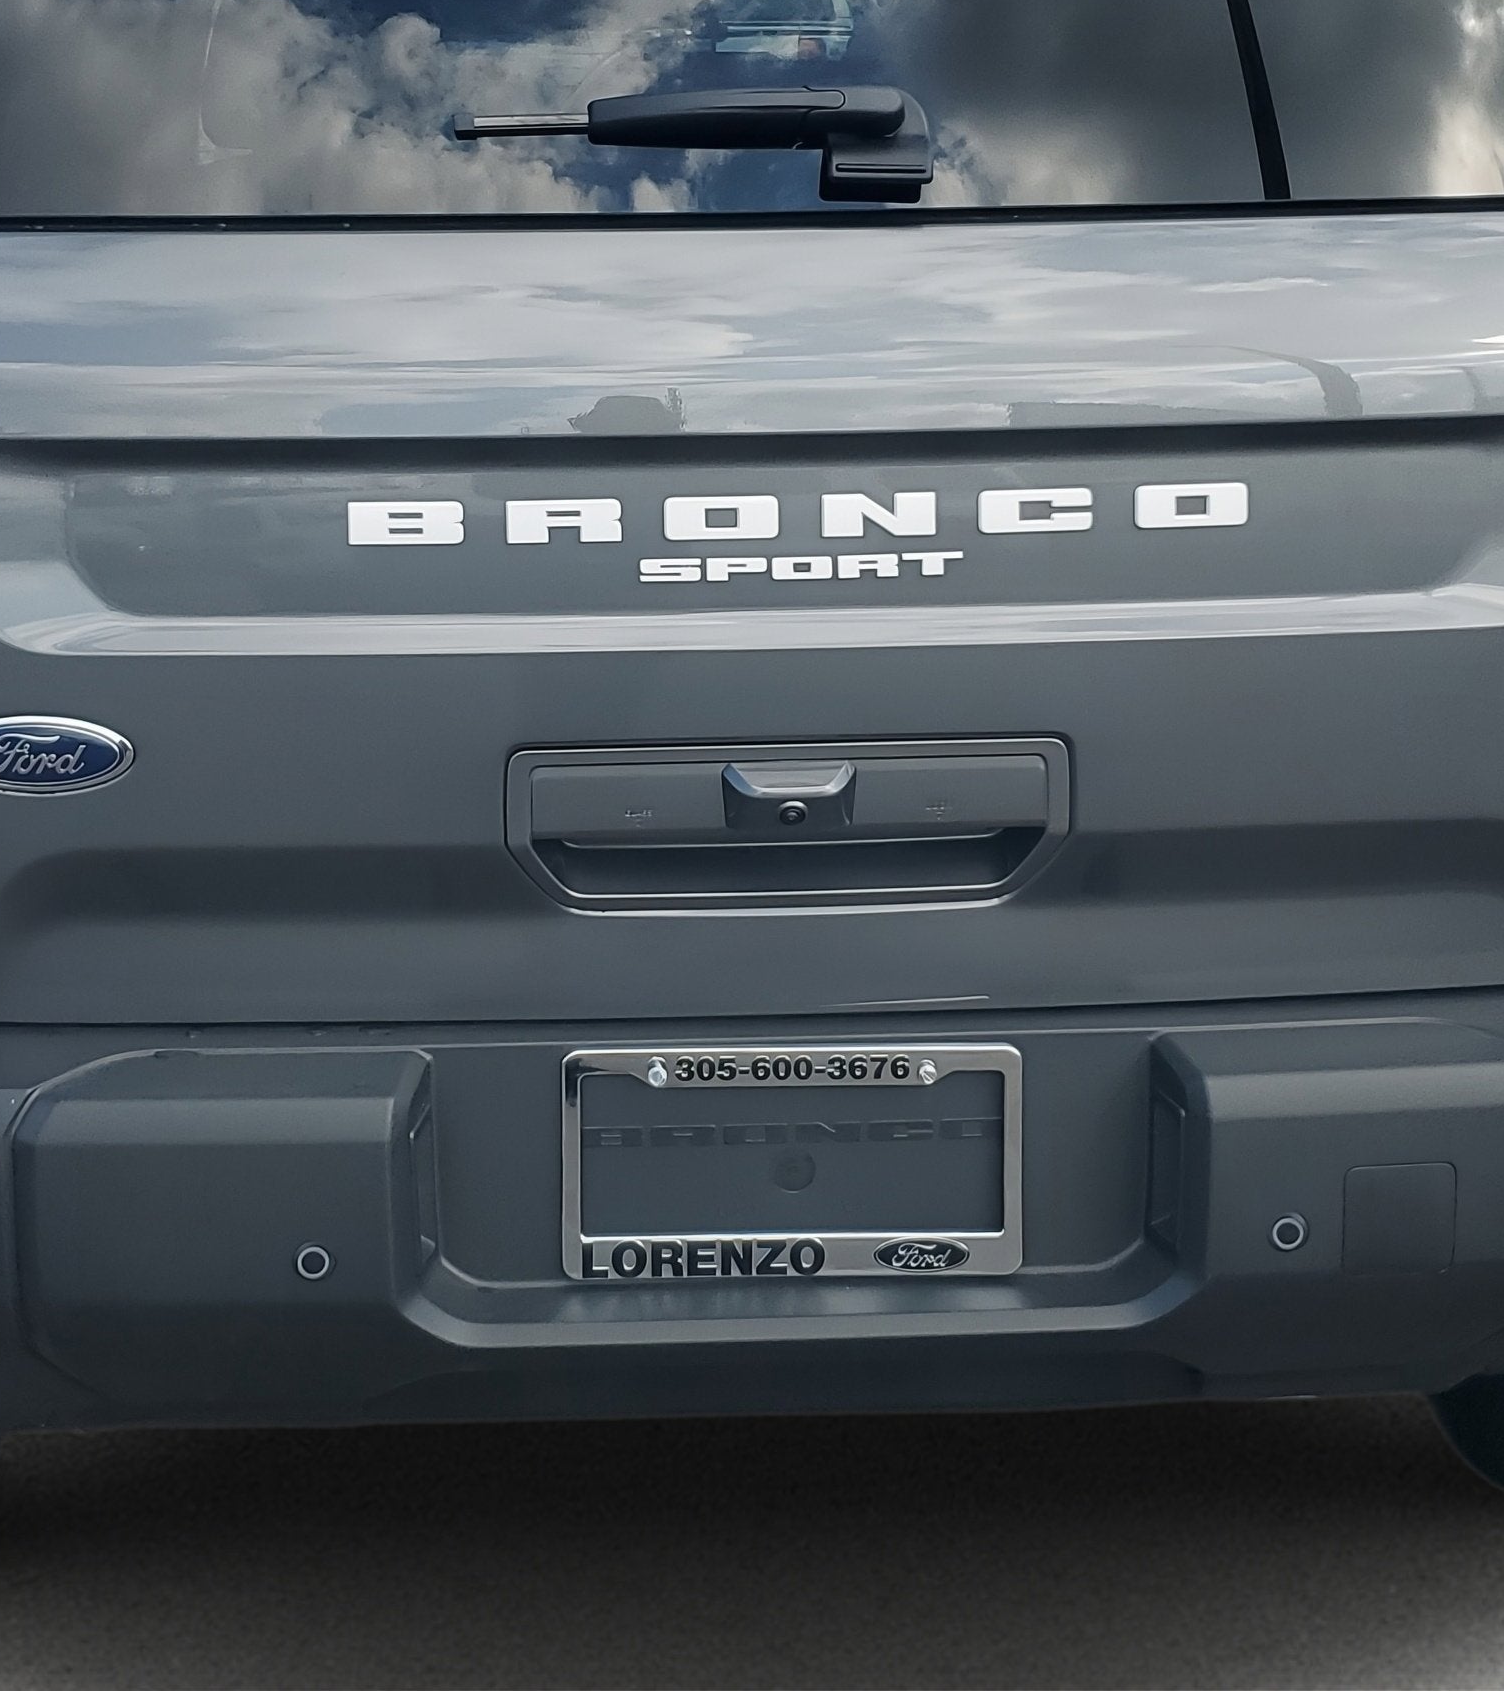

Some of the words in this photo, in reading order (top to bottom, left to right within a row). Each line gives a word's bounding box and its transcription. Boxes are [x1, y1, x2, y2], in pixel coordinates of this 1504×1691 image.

[347, 482, 1249, 546] BRONCO
[639, 550, 963, 583] SPORT
[674, 1054, 911, 1081] 305-600-3676
[581, 1238, 826, 1278] LORENZO
[892, 1242, 952, 1267] Ford
